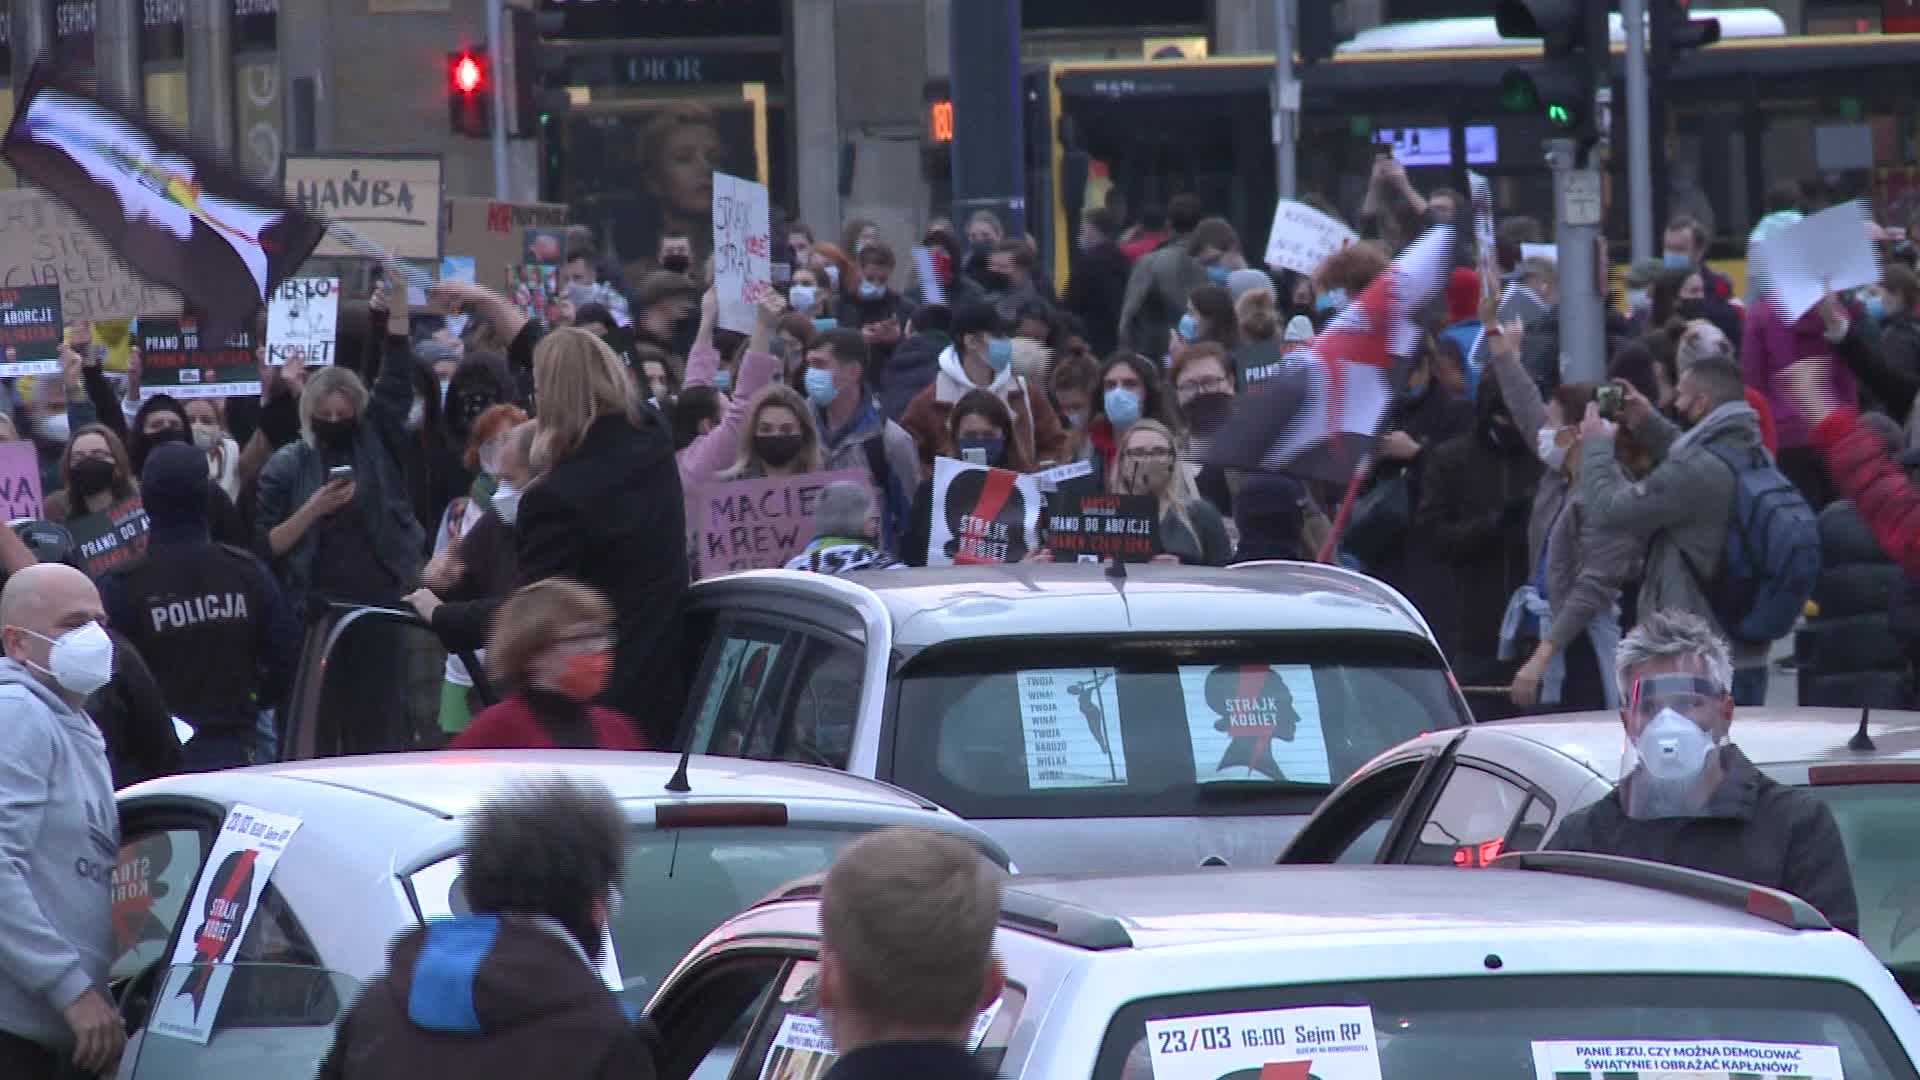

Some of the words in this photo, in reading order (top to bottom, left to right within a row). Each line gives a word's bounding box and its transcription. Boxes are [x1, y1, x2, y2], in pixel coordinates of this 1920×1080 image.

[628, 55, 704, 81] DIOR
[297, 169, 414, 213] HAŃBA
[711, 485, 824, 527] MACIE
[706, 525, 799, 559] KREW
[959, 514, 1009, 542] STRAJK
[151, 592, 248, 632] POLICJA
[1225, 697, 1278, 712] STRAJK
[1230, 713, 1278, 726] KOBIET
[1158, 1026, 1232, 1054] 23/03
[1241, 1027, 1287, 1048] 16:00
[1295, 1025, 1336, 1045] Sejm
[1340, 1022, 1361, 1041] RP
[1576, 1046, 1612, 1057] PANIE
[1615, 1046, 1646, 1057] JEZU,
[1647, 1047, 1671, 1057] CZY
[1673, 1044, 1721, 1057] MOŻNA
[1723, 1046, 1801, 1061] DEMOLOWAĆ
[1584, 1058, 1653, 1072] ŚWIĄTYNIE
[1660, 1058, 1721, 1071] OBRAŻAĆ
[1721, 1060, 1799, 1074] KAPŁANÓW?
